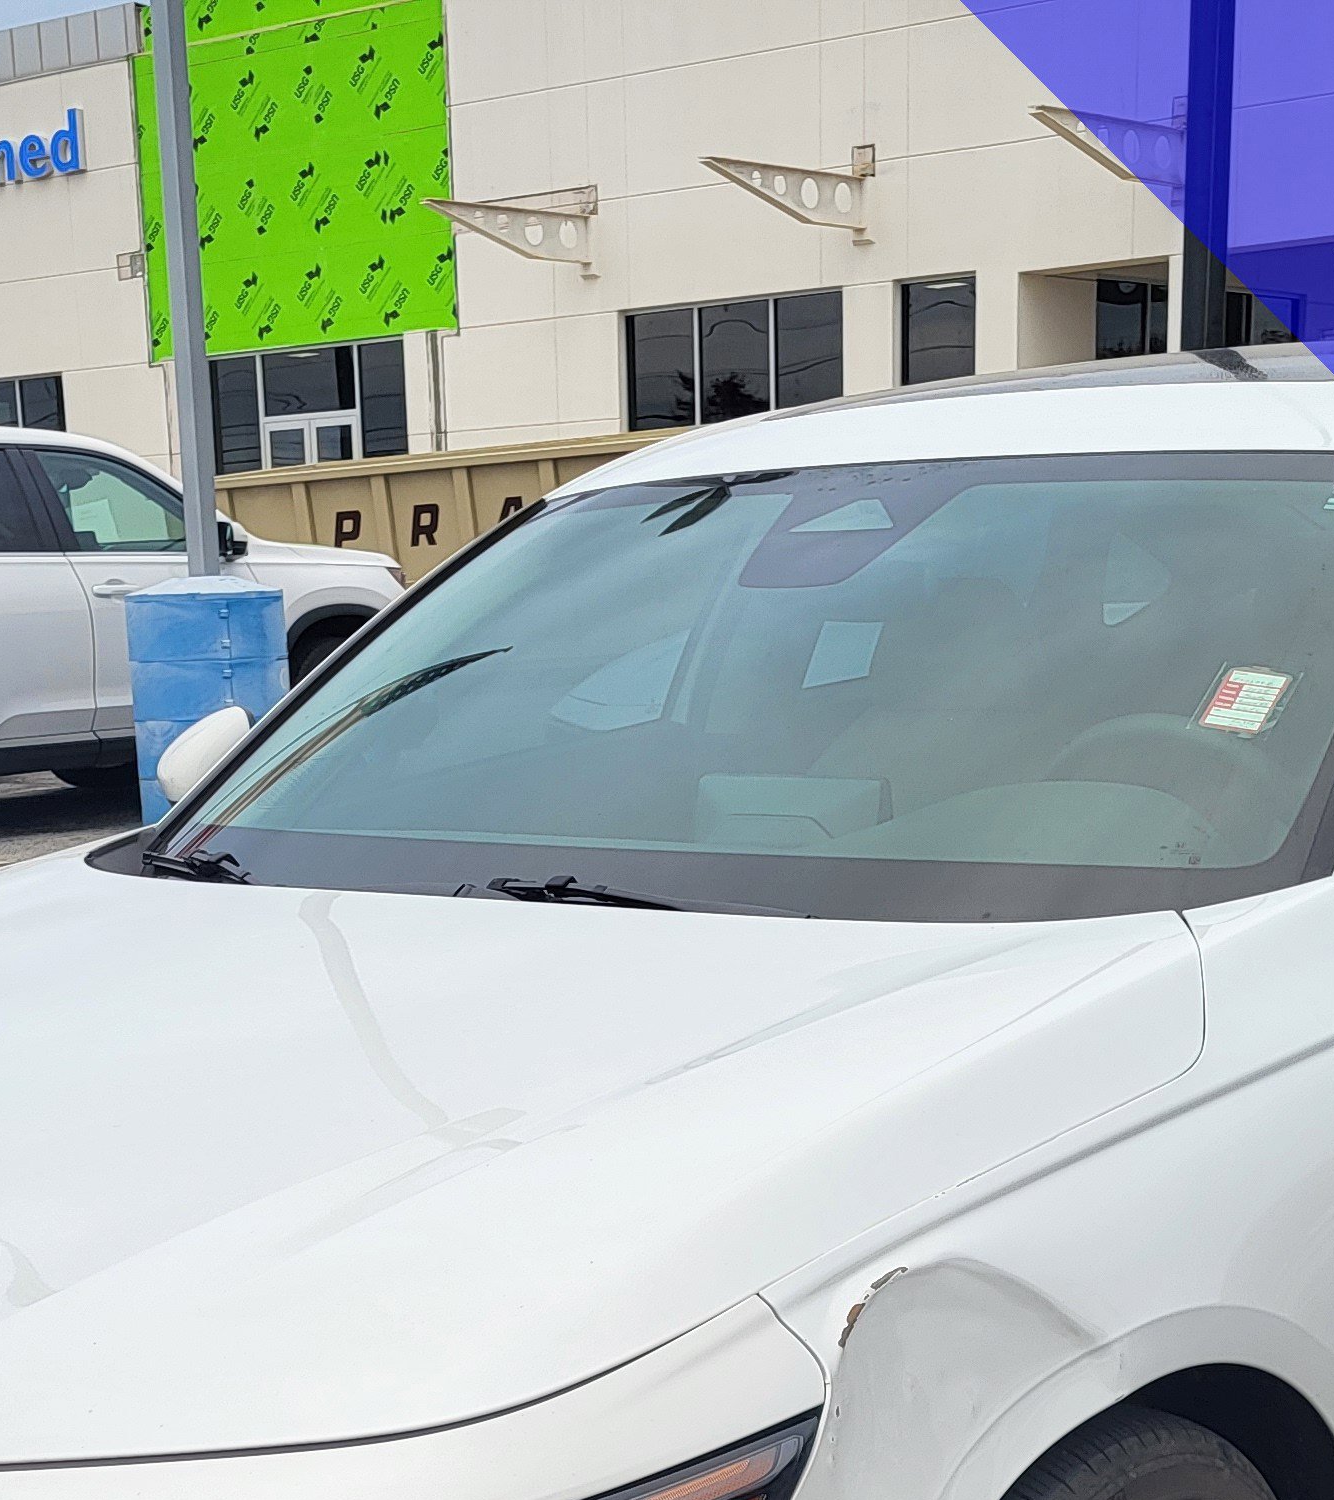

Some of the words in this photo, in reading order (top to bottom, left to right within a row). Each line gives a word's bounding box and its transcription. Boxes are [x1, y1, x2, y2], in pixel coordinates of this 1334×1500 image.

[418, 51, 434, 74] USG
[349, 64, 365, 87] USG
[294, 76, 309, 98] USG
[385, 78, 400, 101] USG
[231, 88, 245, 110] USG
[318, 91, 333, 113] USG
[201, 113, 216, 134] USG
[264, 102, 278, 124] USG
[355, 169, 371, 191] USG
[432, 158, 448, 181] USG
[238, 189, 252, 210] USG
[290, 180, 305, 201] USG
[399, 184, 415, 206] USG
[261, 204, 275, 225] USG
[324, 194, 339, 216] USG
[148, 222, 162, 242] USG
[208, 212, 222, 234] USG
[359, 273, 374, 294] USG
[427, 264, 443, 286] USG
[235, 289, 249, 310] USG
[297, 281, 312, 301] USG
[394, 288, 410, 309] USG
[267, 303, 282, 324] USG
[328, 296, 343, 317] USG
[156, 318, 170, 338] USG
[206, 311, 220, 331] USG
